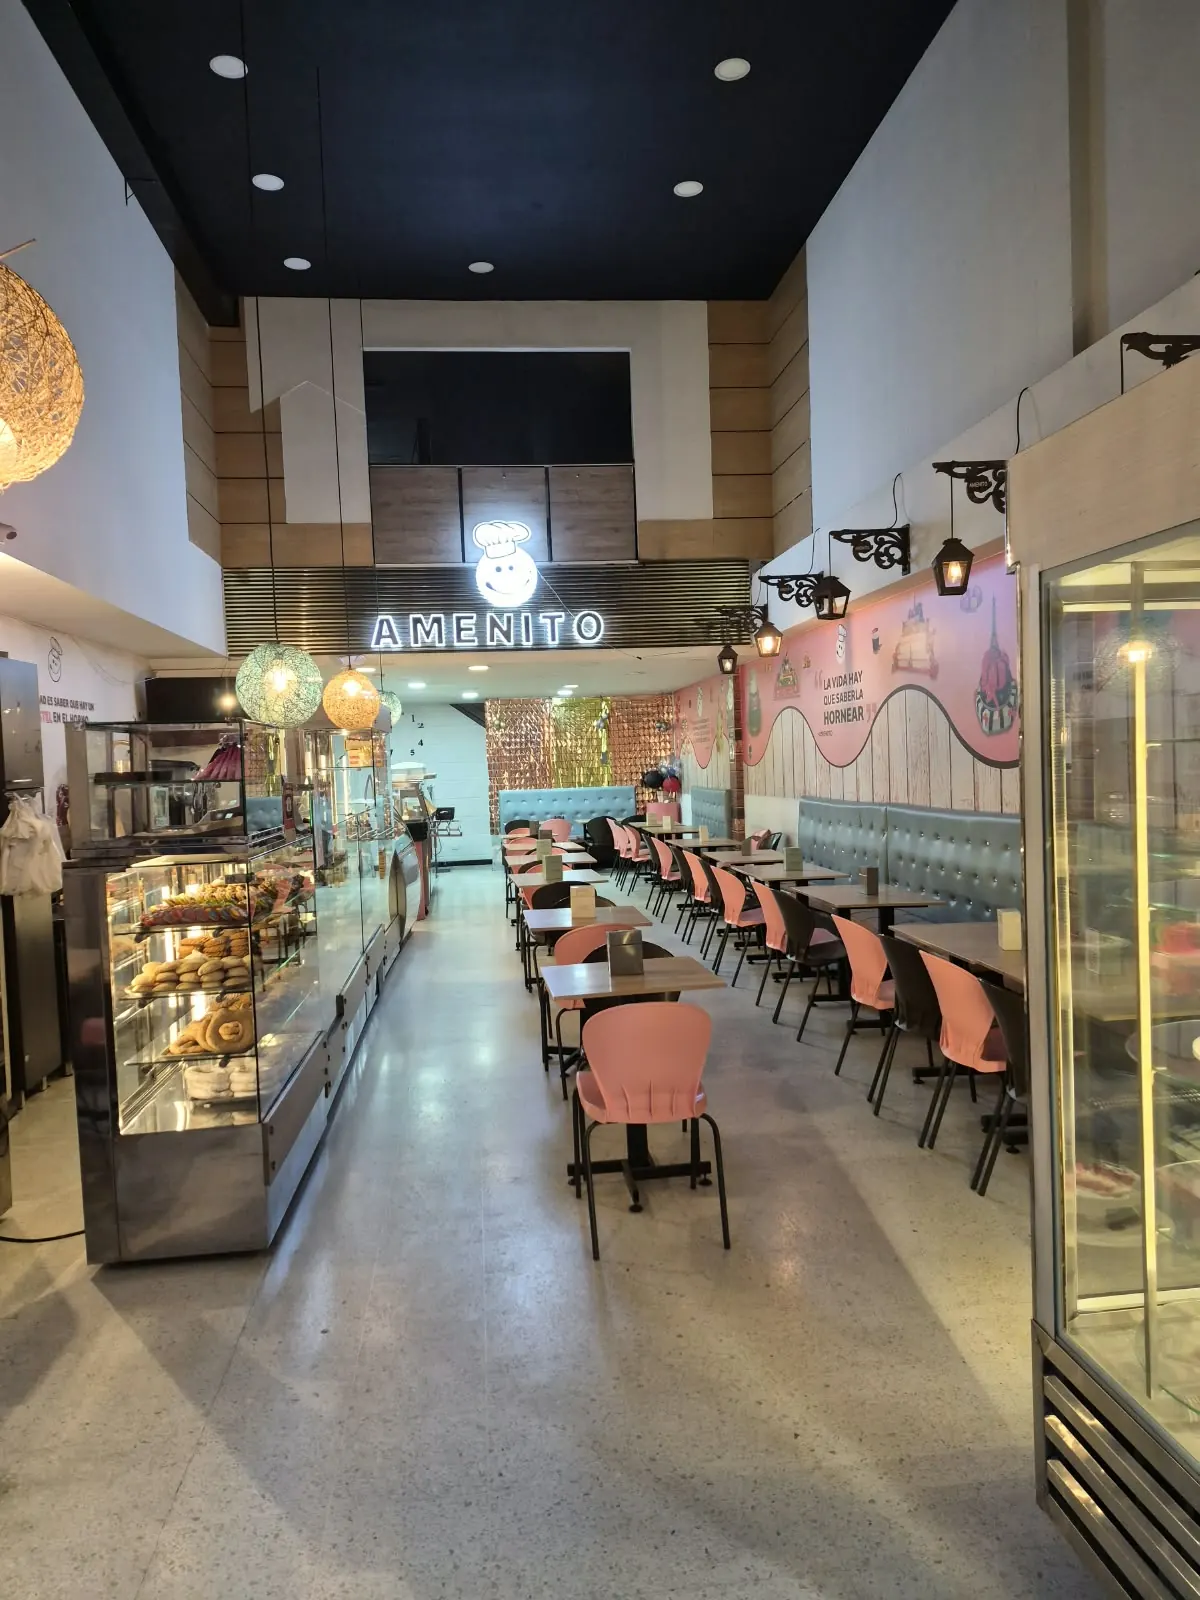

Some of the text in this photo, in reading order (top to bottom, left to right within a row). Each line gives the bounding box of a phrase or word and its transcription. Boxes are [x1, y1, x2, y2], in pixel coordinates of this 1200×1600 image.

[371, 611, 604, 649] AMENITO
[823, 670, 863, 690] LA VIDA HAY
[54, 697, 70, 708] SABER
[823, 694, 835, 706] QUE
[53, 712, 62, 723] EN
[823, 705, 865, 726] HORNEAR
